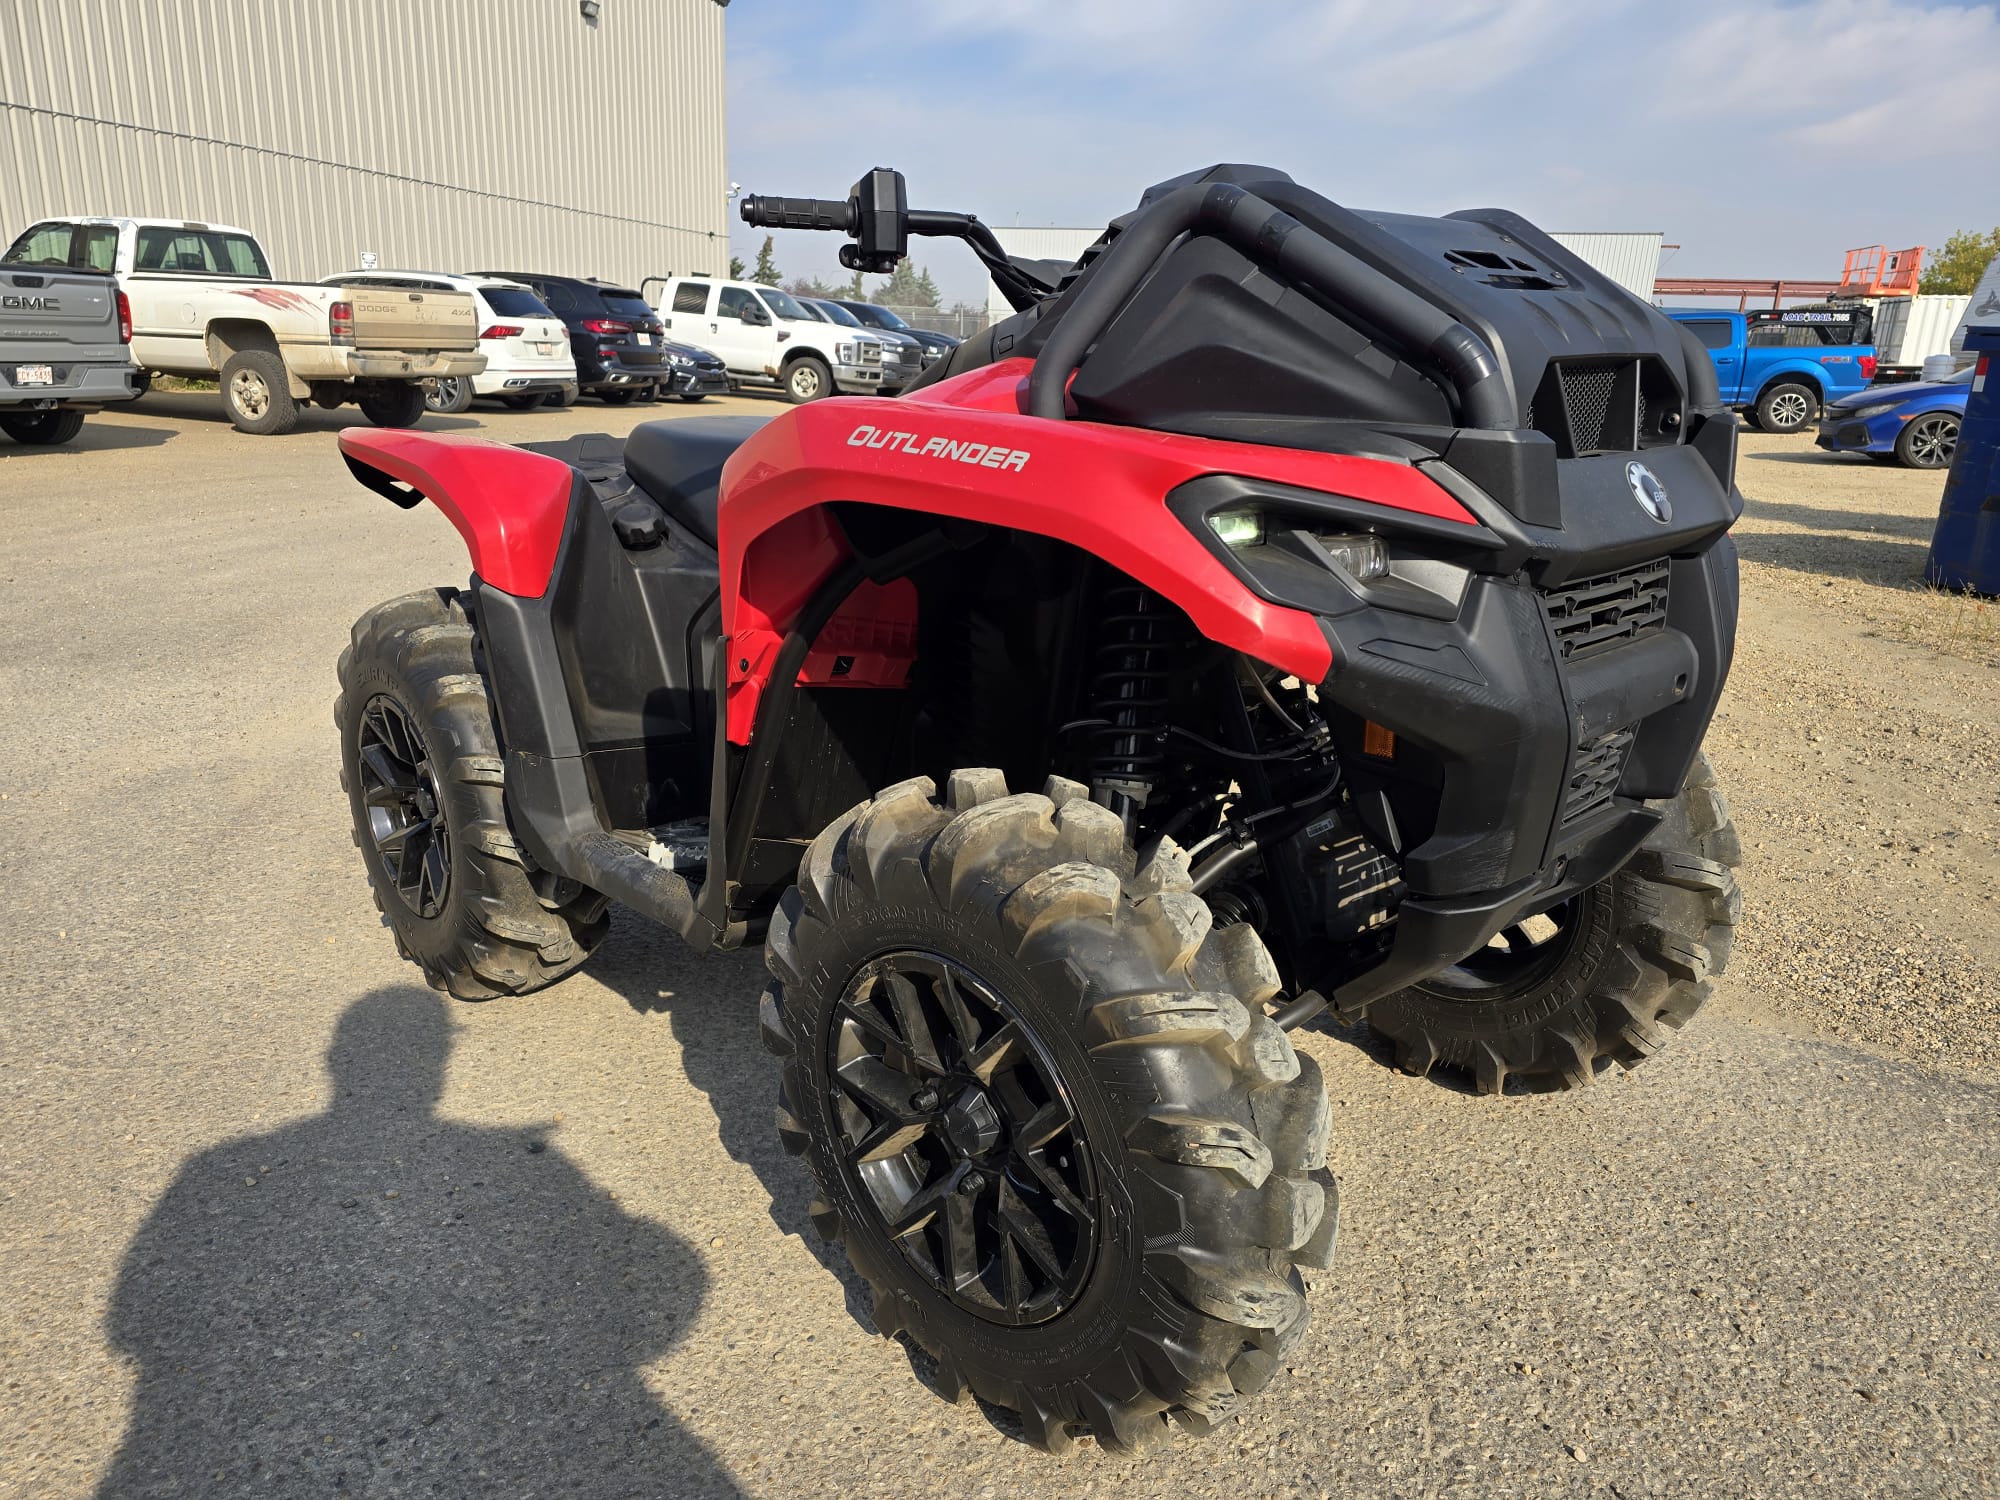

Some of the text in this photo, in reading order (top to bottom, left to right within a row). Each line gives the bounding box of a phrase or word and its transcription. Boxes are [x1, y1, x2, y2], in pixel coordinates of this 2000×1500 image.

[1, 295, 61, 311] GMC
[358, 304, 398, 313] DODGE
[1781, 312, 1804, 321] LOAD
[1808, 312, 1832, 322] TRAIL
[3, 329, 60, 337] SIERRA
[847, 425, 1031, 472] OUTLANDER
